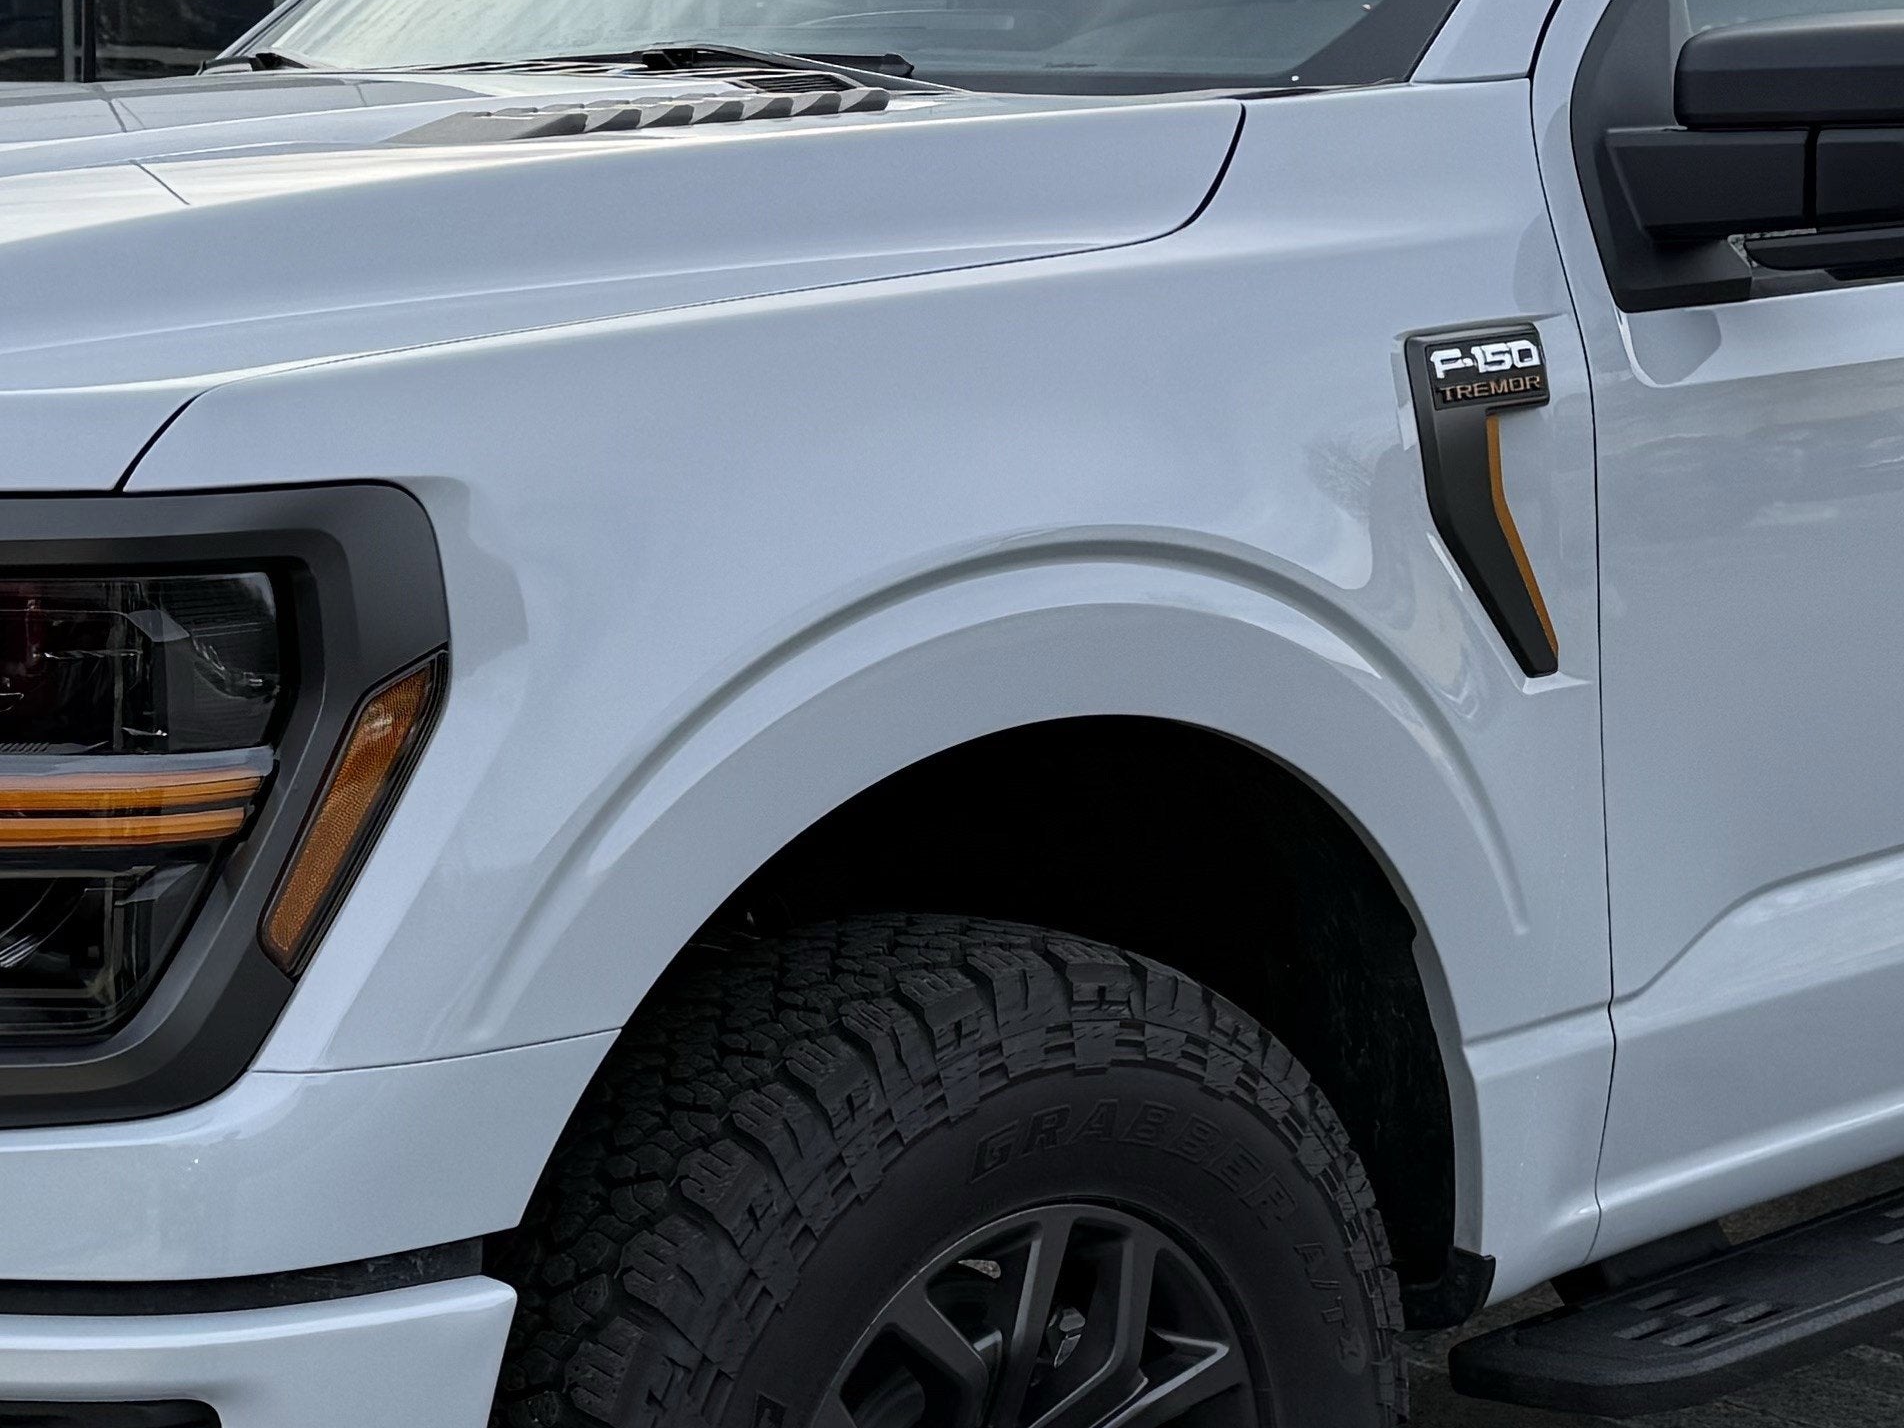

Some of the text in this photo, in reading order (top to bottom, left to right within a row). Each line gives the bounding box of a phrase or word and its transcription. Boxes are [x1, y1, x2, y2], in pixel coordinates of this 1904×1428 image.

[1430, 339, 1541, 379] F-150
[1440, 375, 1540, 401] TREMOR
[969, 1098, 1297, 1231] GRABBER
